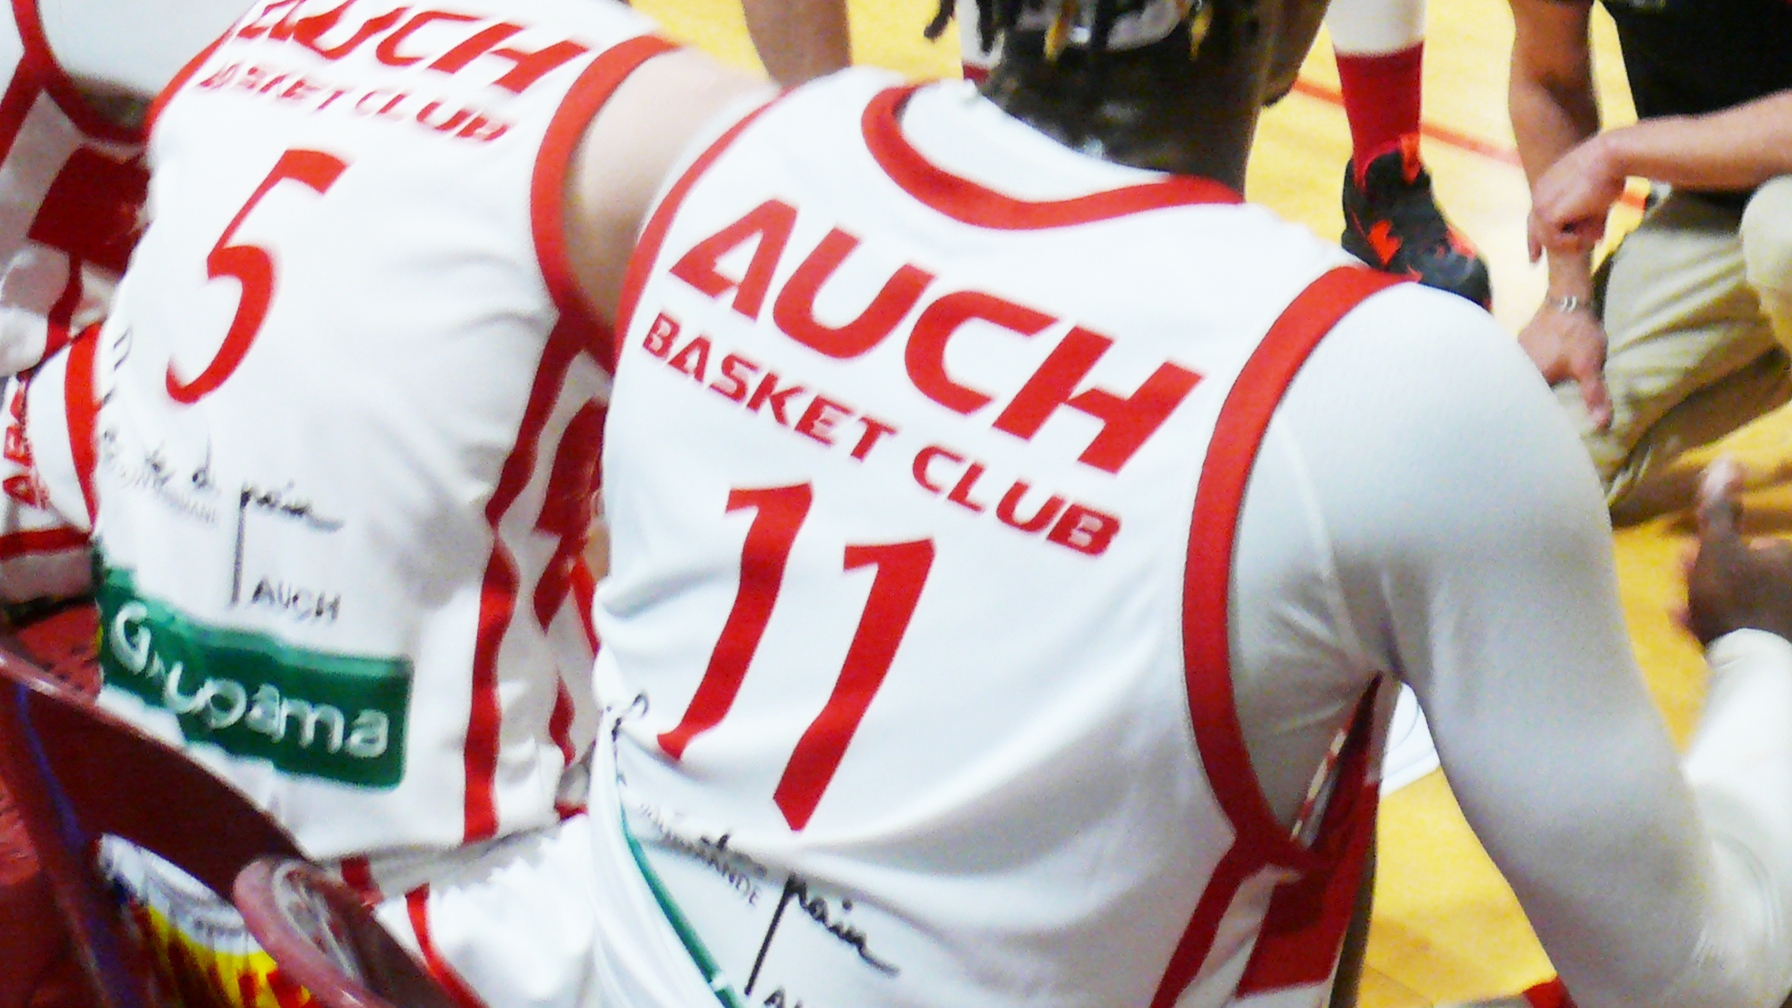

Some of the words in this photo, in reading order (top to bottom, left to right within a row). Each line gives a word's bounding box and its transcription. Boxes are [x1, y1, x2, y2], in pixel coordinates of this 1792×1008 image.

[165, 148, 352, 404] 5
[668, 198, 1206, 475] AUCH
[641, 310, 898, 463] BASKET
[911, 443, 1124, 558] CLUB
[251, 575, 342, 624] AUCH
[655, 481, 936, 832] 11
